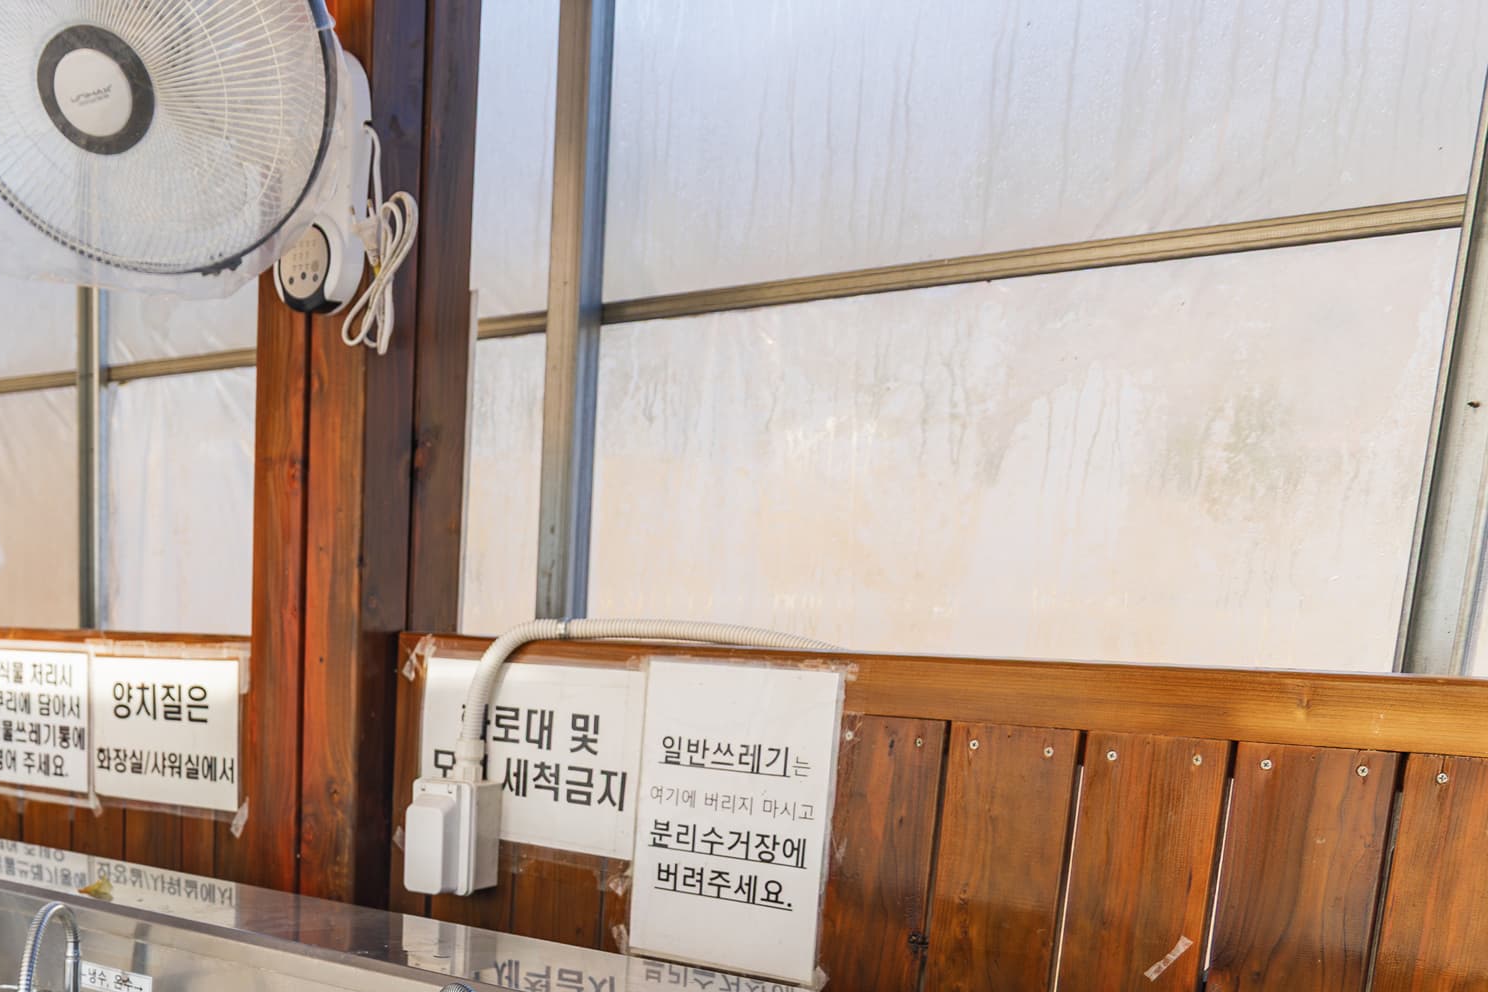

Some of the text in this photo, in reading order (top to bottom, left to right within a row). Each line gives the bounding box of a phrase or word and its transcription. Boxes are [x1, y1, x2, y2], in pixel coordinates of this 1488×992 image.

[31, 664, 72, 686] 처리시
[38, 693, 80, 719] 담아서
[113, 682, 209, 723] 양치질은
[570, 713, 600, 755] 및
[24, 752, 69, 777] 주세요.
[97, 748, 235, 784] 화장실/샤워실에서
[662, 736, 811, 777] 일반쓰레기는
[502, 758, 628, 811] 세척금지
[650, 785, 815, 821] 여기에 버리지 마시고
[649, 819, 807, 869] 분리수거장에
[655, 862, 792, 911] 버려주세요.
